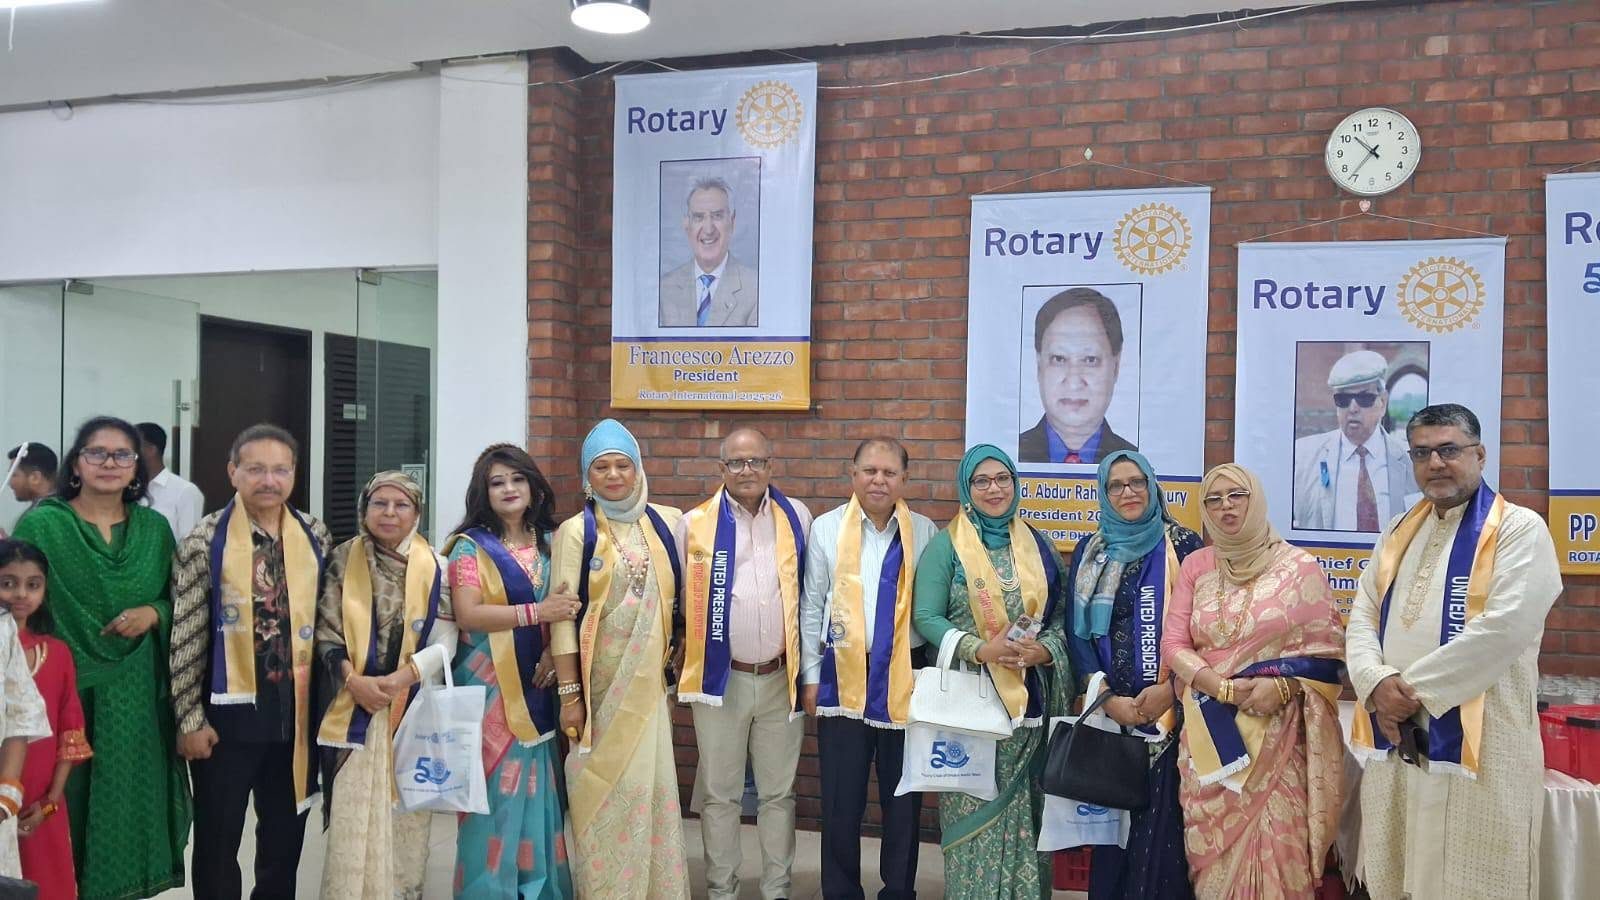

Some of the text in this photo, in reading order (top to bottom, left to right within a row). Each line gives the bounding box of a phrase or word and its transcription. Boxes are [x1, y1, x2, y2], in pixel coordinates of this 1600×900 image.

[628, 106, 728, 136] Rotary
[1368, 119, 1378, 127] 12
[1388, 121, 1392, 130] 1
[1352, 123, 1362, 132] 11
[1341, 135, 1351, 143] 10
[1398, 132, 1404, 140] 2
[1337, 149, 1344, 158] 9
[1402, 146, 1408, 154] 3
[1397, 161, 1403, 169] 4
[1352, 174, 1359, 182] 7
[1385, 172, 1391, 180] 5
[1565, 212, 1600, 245] R
[985, 228, 1103, 260] Rotary
[1253, 279, 1386, 315] Rotary
[629, 345, 794, 366] Francesco Arezzo
[674, 369, 738, 382] President
[639, 390, 669, 400] Rotary
[673, 389, 736, 400] International
[1021, 484, 1187, 505] d. Abdur Rah ury
[1019, 509, 1100, 521] President 20
[1570, 514, 1596, 540] PP
[1051, 531, 1067, 540] OF
[1316, 556, 1353, 569] hief
[1328, 573, 1359, 589] hm
[712, 550, 728, 642] UNITED PRESIDENT
[1449, 576, 1469, 620] UNITED
[1140, 586, 1157, 682] UNITED PRESIDENT
